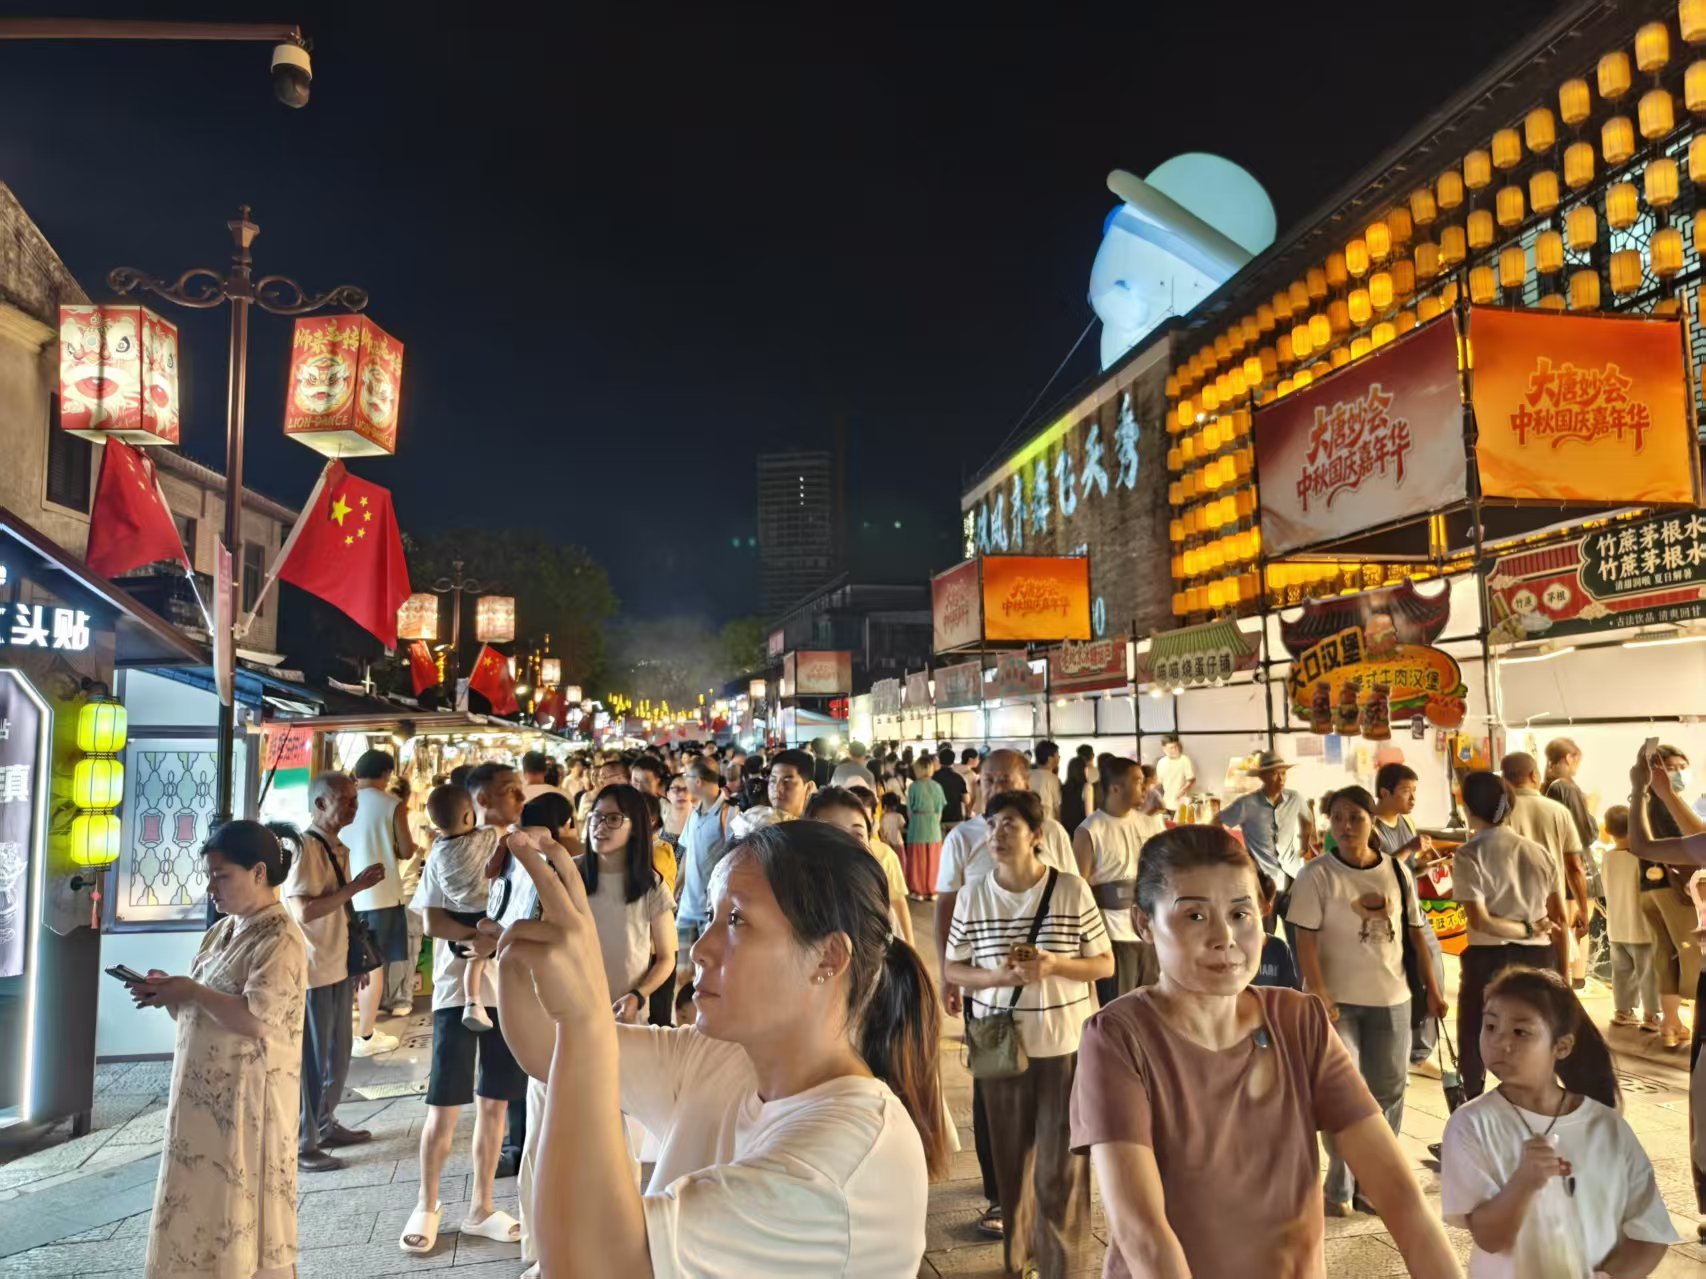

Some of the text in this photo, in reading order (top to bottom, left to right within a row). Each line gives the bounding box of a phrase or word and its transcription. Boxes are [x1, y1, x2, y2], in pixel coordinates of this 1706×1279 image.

[1525, 356, 1632, 408] 大唐妙会
[1306, 383, 1394, 466] 大唐妙会
[1510, 402, 1650, 453] 中秋国庆嘉年华
[1296, 418, 1411, 513] 中秋国庆嘉年华
[1596, 513, 1706, 557] 竹蔗茅根水
[1598, 540, 1706, 581] 竹蔗茅根水
[0, 603, 90, 650] 头贴
[1288, 632, 1362, 699] 大口汉堡
[0, 764, 30, 802] 真
